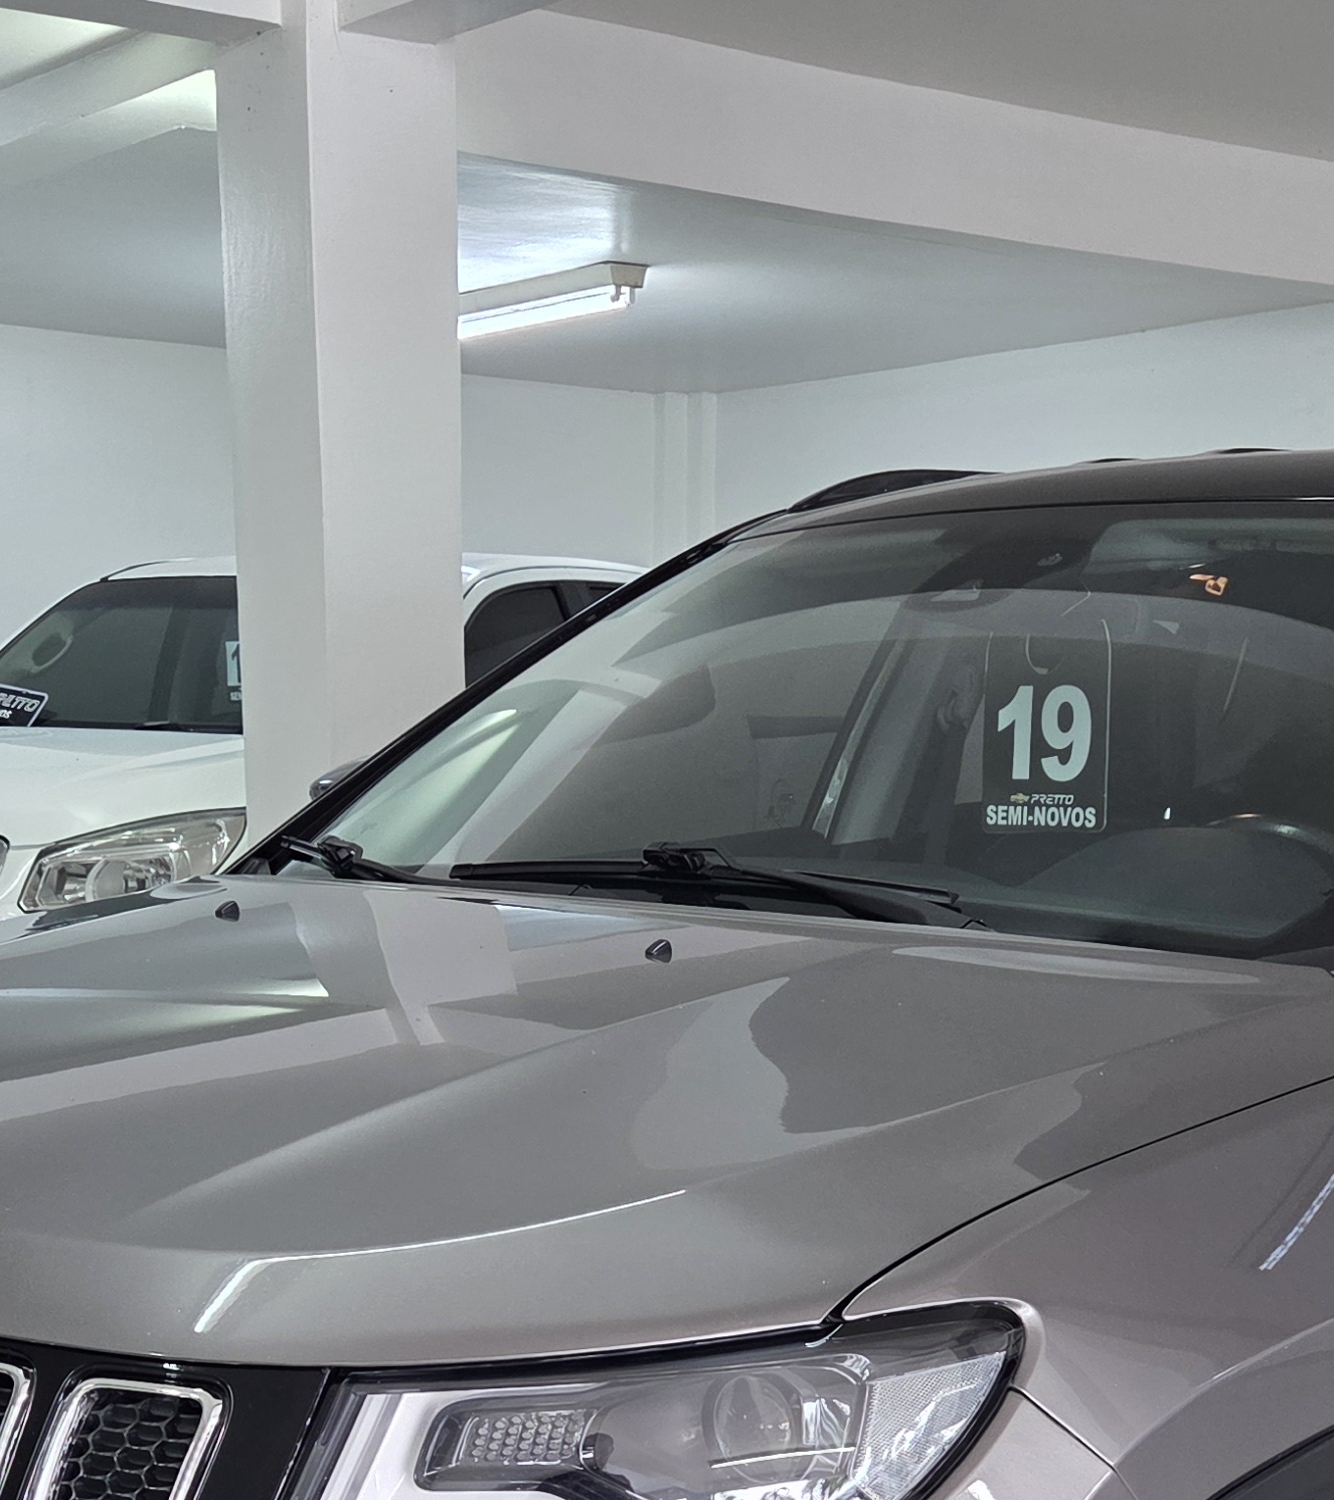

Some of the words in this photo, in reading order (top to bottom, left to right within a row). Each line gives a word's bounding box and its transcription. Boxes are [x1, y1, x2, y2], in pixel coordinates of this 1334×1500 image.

[998, 685, 1091, 781] 19
[1030, 793, 1075, 805] PRETTO
[986, 804, 1097, 828] SEMI-NOVOS
